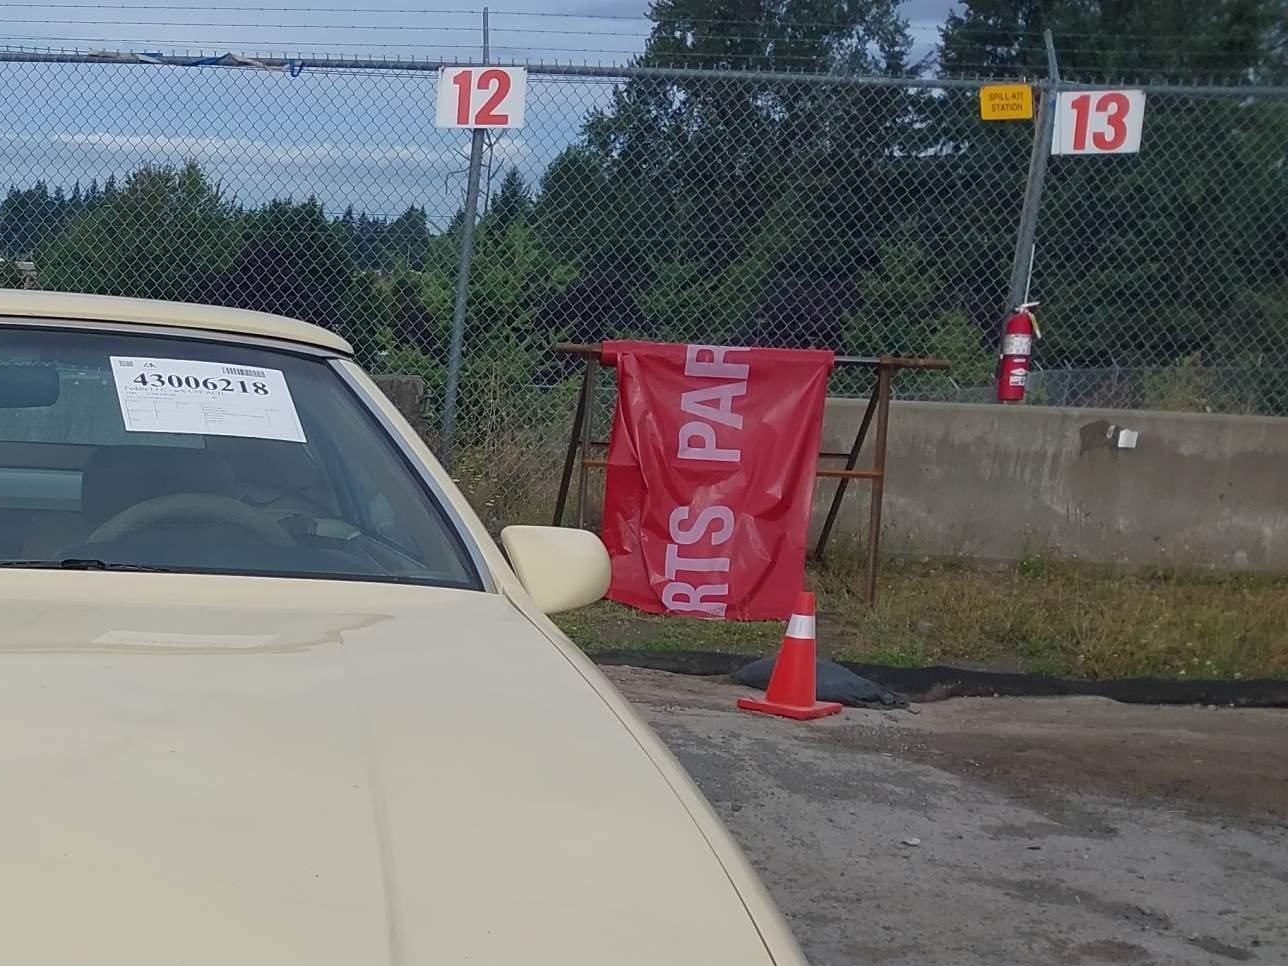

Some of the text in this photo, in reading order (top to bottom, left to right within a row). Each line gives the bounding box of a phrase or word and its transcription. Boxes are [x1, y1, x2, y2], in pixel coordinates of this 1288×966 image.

[453, 69, 510, 125] 12
[991, 103, 1023, 112] STATION
[1071, 92, 1130, 151] 13
[132, 372, 270, 396] 43006218
